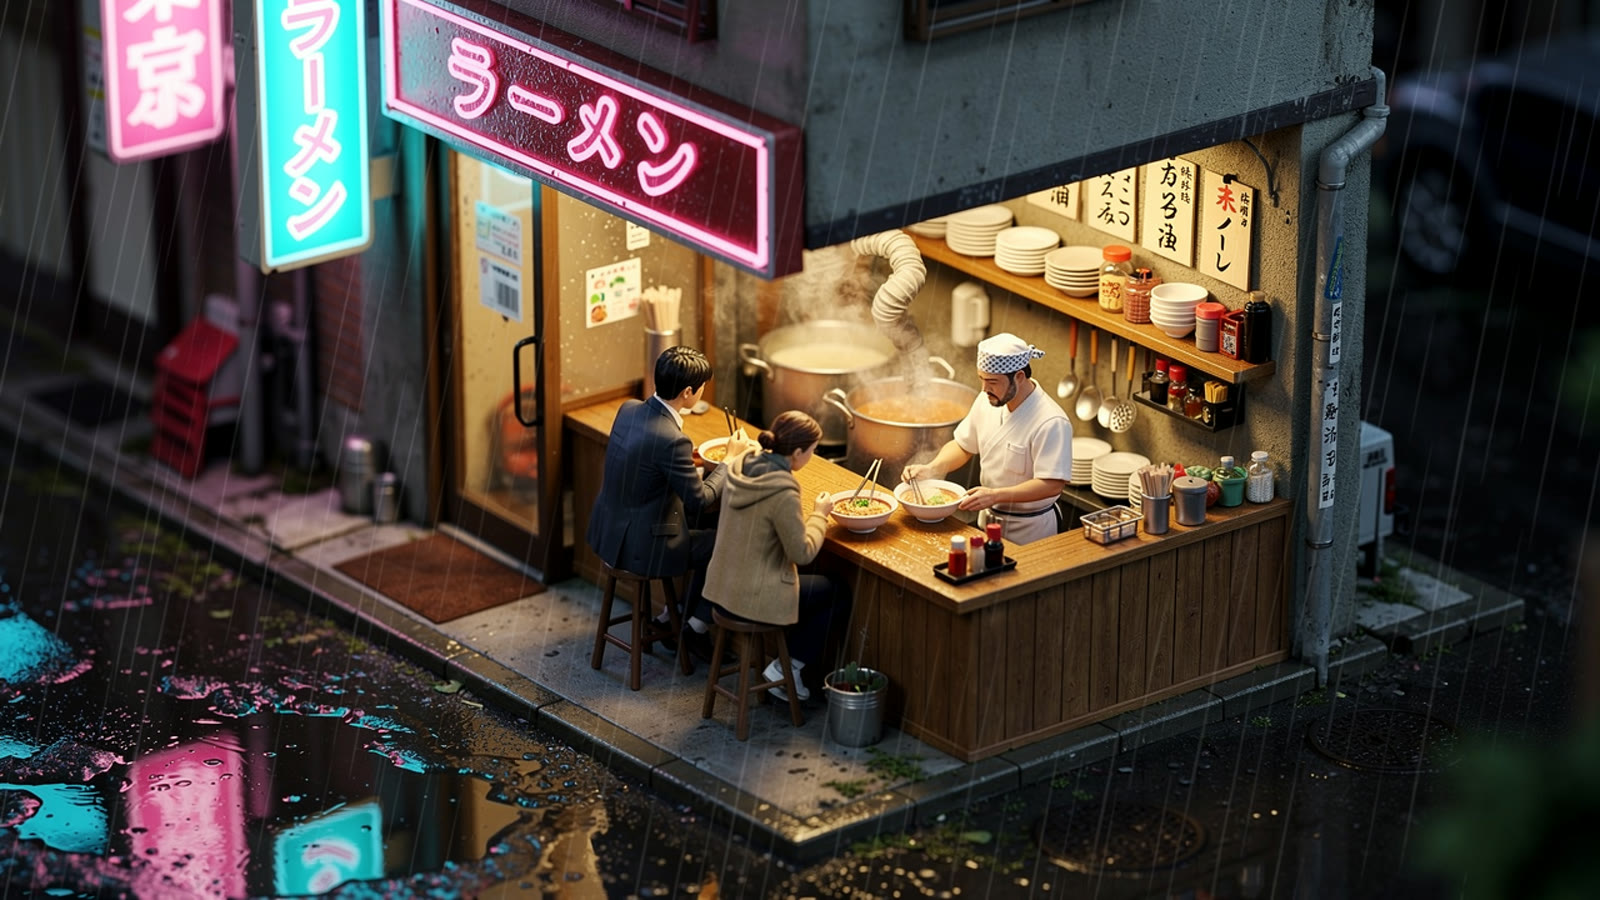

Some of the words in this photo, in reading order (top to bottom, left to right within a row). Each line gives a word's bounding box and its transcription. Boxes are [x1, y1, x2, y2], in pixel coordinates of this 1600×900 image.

[281, 0, 348, 241] ラーメン
[447, 37, 698, 197] ラーメン
